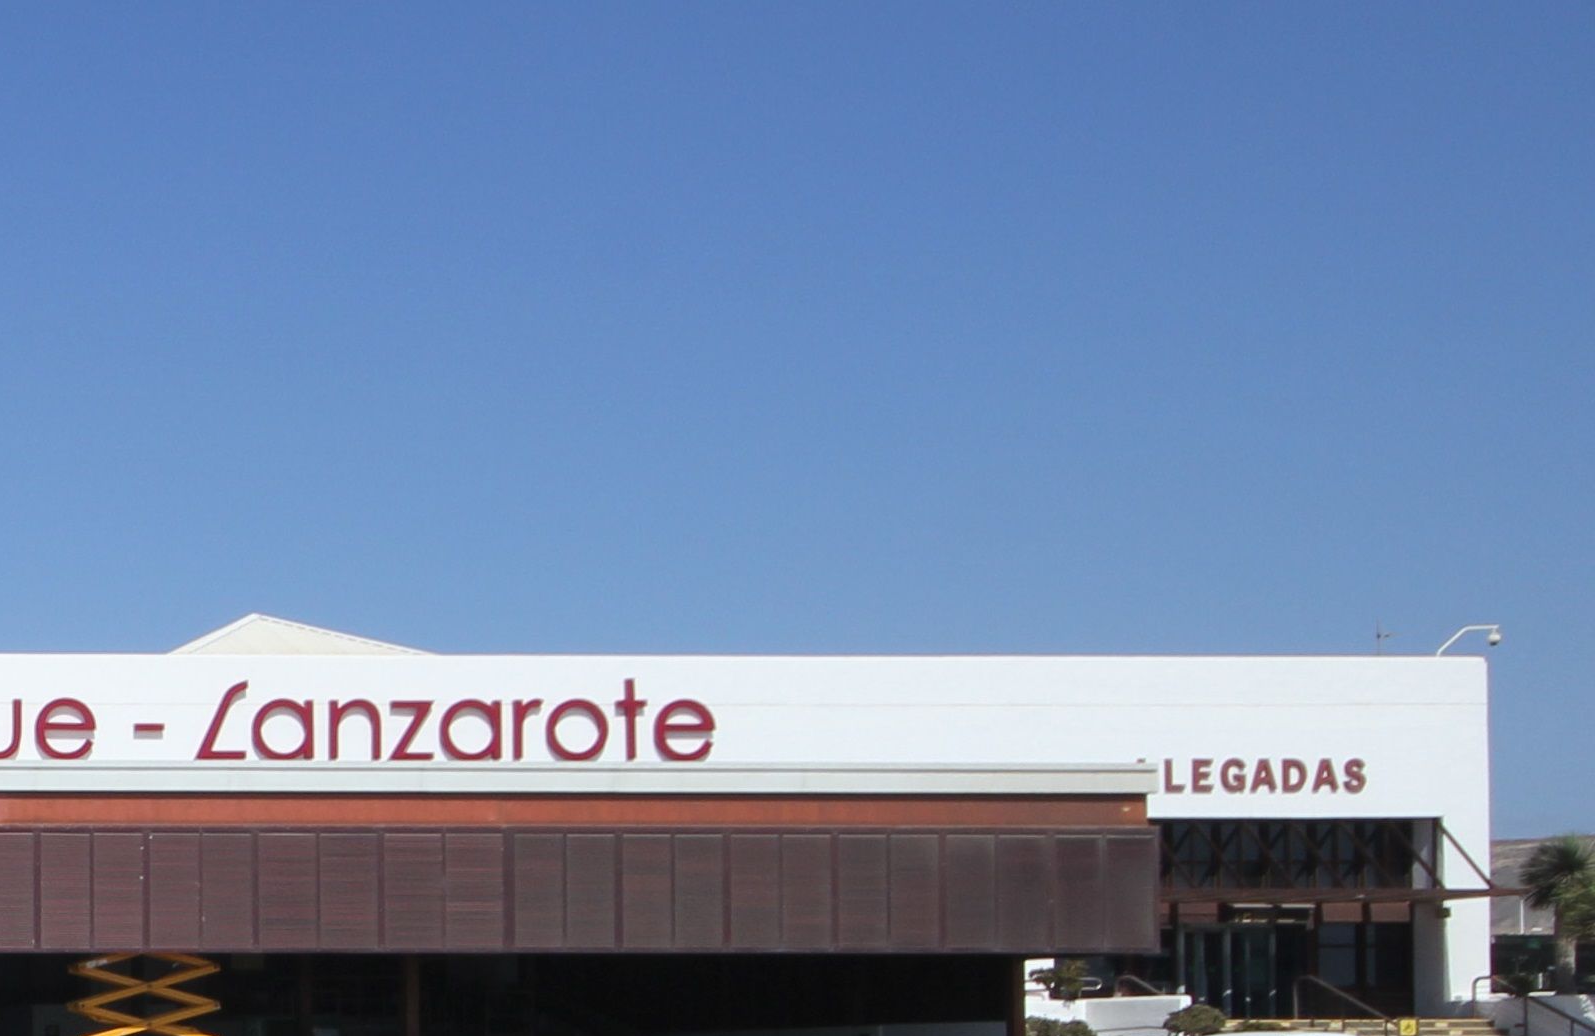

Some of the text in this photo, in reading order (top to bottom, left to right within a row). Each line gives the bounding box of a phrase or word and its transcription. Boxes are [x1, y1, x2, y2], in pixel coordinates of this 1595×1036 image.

[133, 723, 165, 732] -
[195, 678, 717, 761] Lanzarote
[1137, 757, 1367, 795] LEGADAS
